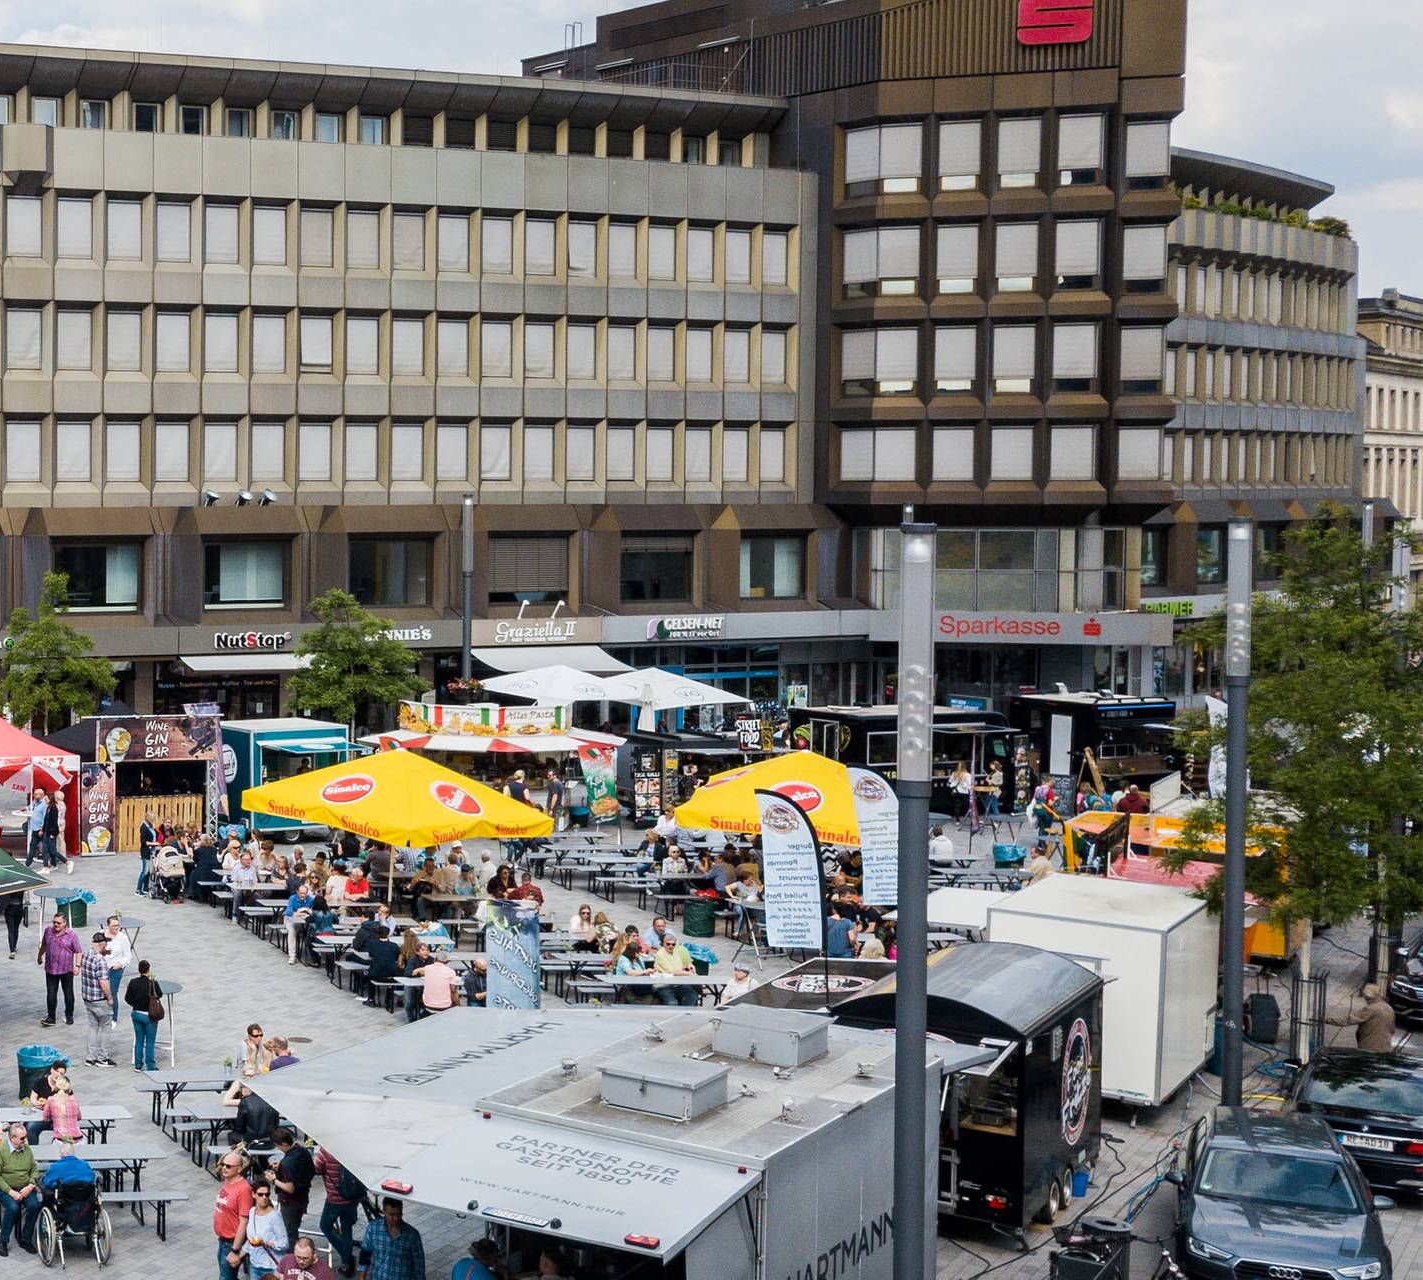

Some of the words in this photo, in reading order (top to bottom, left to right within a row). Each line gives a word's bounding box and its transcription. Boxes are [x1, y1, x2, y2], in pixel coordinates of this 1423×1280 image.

[663, 617, 724, 630] GELSEN-NET
[939, 615, 1060, 638] Sparkasse
[495, 621, 562, 643] Graziella
[563, 621, 577, 636] II
[529, 710, 555, 720] Pasta
[145, 720, 169, 731] WINE
[735, 719, 761, 732] STREET
[145, 732, 169, 745] GIN
[740, 731, 760, 744] FOOD
[145, 746, 169, 758] BAR
[88, 790, 109, 800] WINE
[325, 783, 371, 795] Sinalco
[792, 790, 819, 801] alco
[88, 802, 109, 813] GIN
[268, 799, 306, 818] Sinalco
[88, 813, 110, 824] BAR
[711, 815, 762, 833] Sinalco
[340, 815, 380, 838] Sinalco
[495, 824, 528, 835] Sinalco
[433, 827, 466, 844] Sinalco
[814, 825, 860, 845] Sinalc
[416, 1021, 563, 1073] HARTMANN
[509, 1134, 622, 1165] PARTNER
[628, 1159, 680, 1176] DER
[495, 1141, 678, 1186] GASTRONOMIE
[516, 1155, 571, 1172] SEIT
[576, 1168, 632, 1186] 1890
[460, 1176, 626, 1216] WWW.HARTMANN.RUHR
